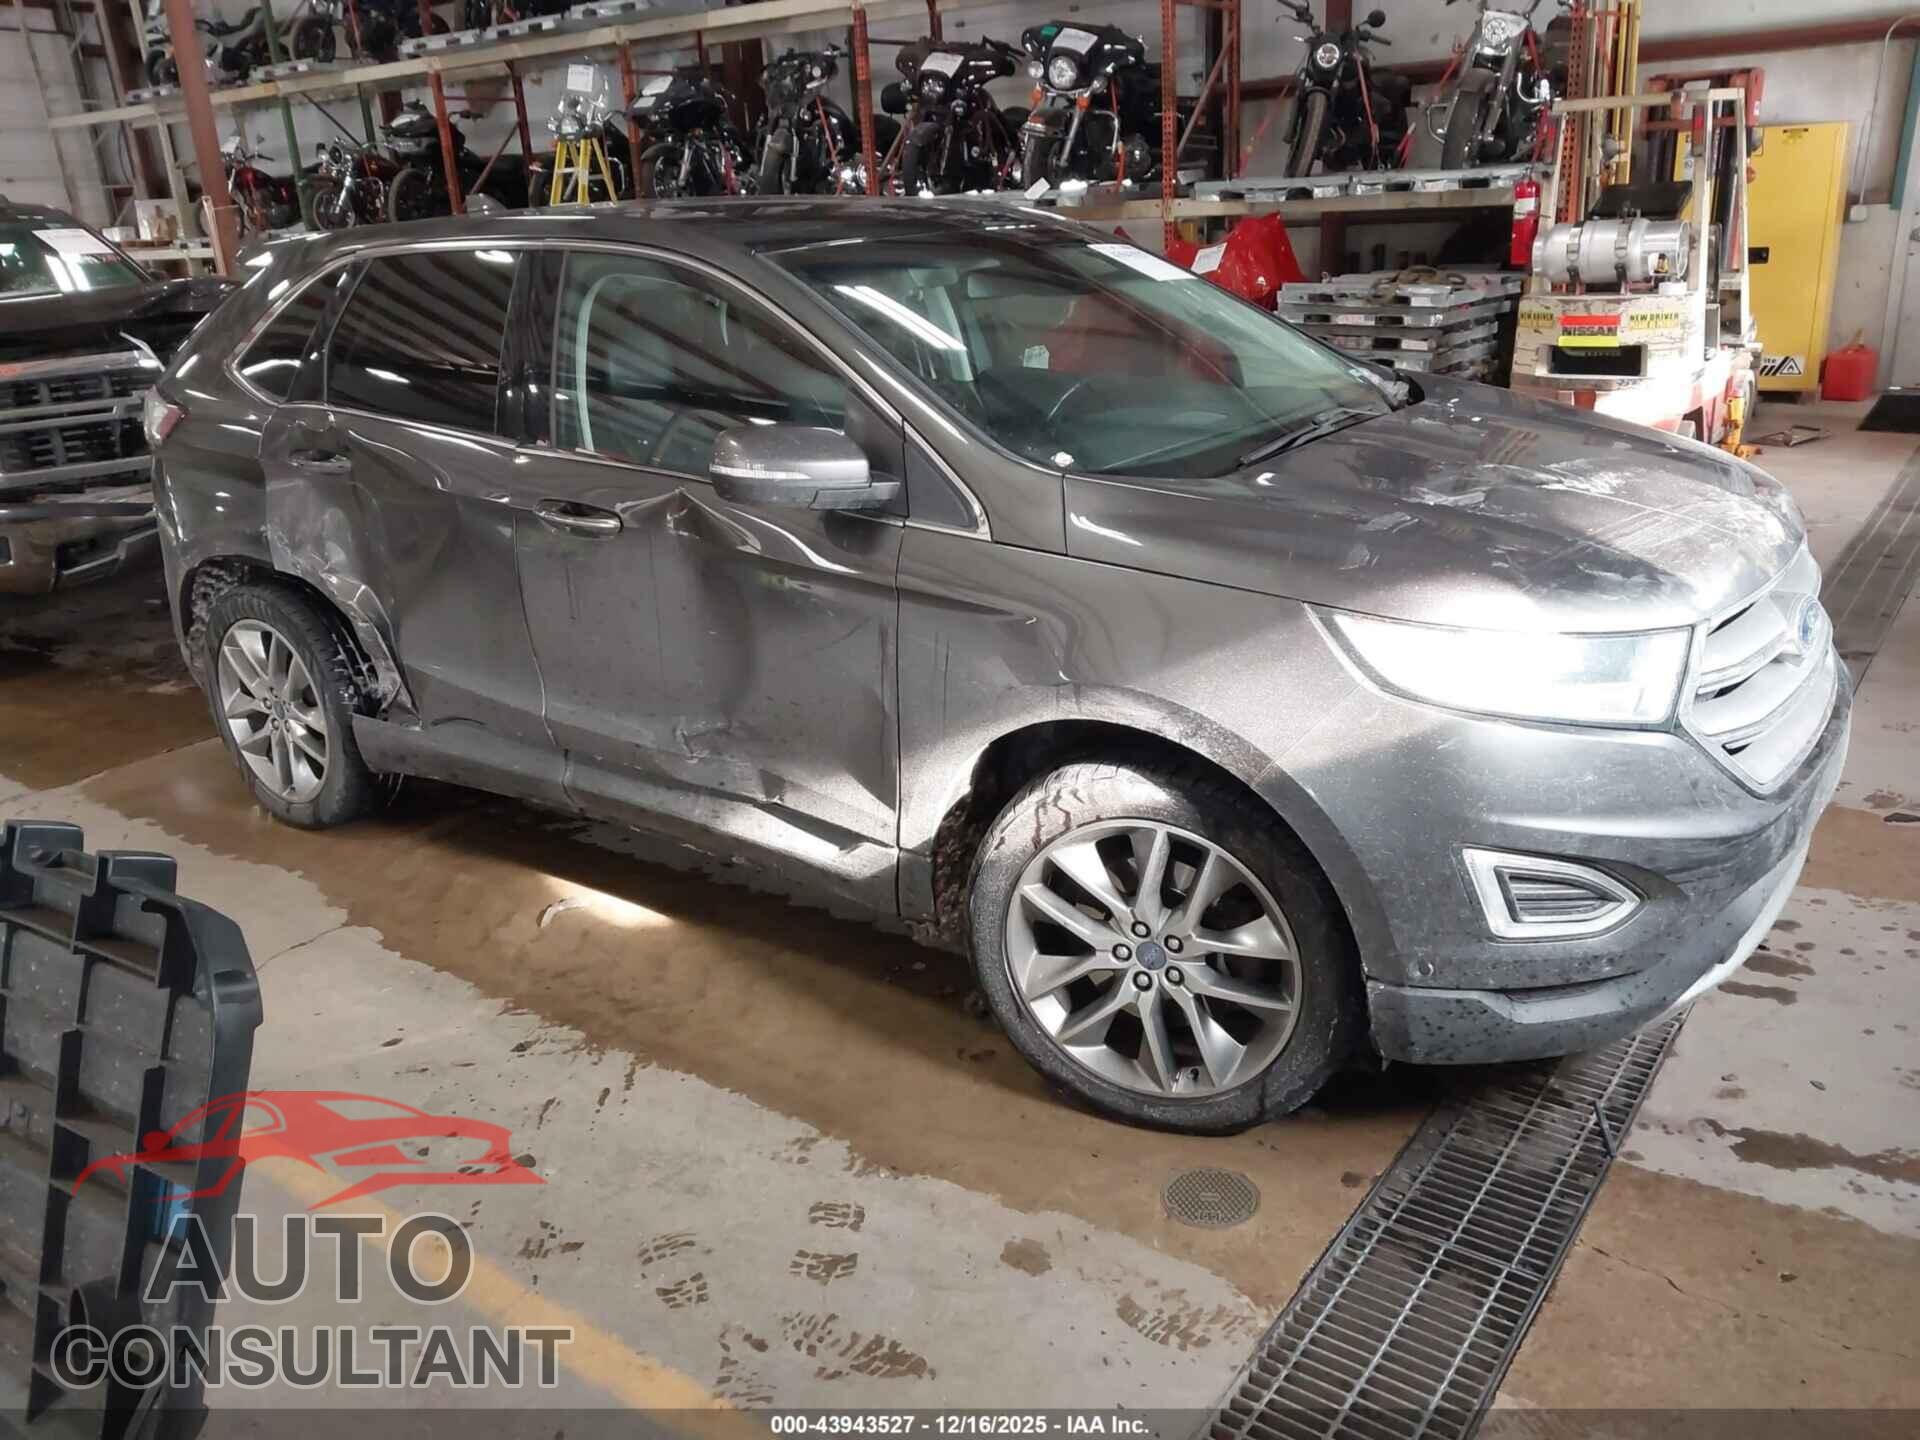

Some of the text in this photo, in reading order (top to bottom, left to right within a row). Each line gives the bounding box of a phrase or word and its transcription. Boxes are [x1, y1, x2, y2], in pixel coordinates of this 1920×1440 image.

[1629, 311, 1679, 321] NEW DRIVER
[1561, 326, 1618, 337] NISSAN
